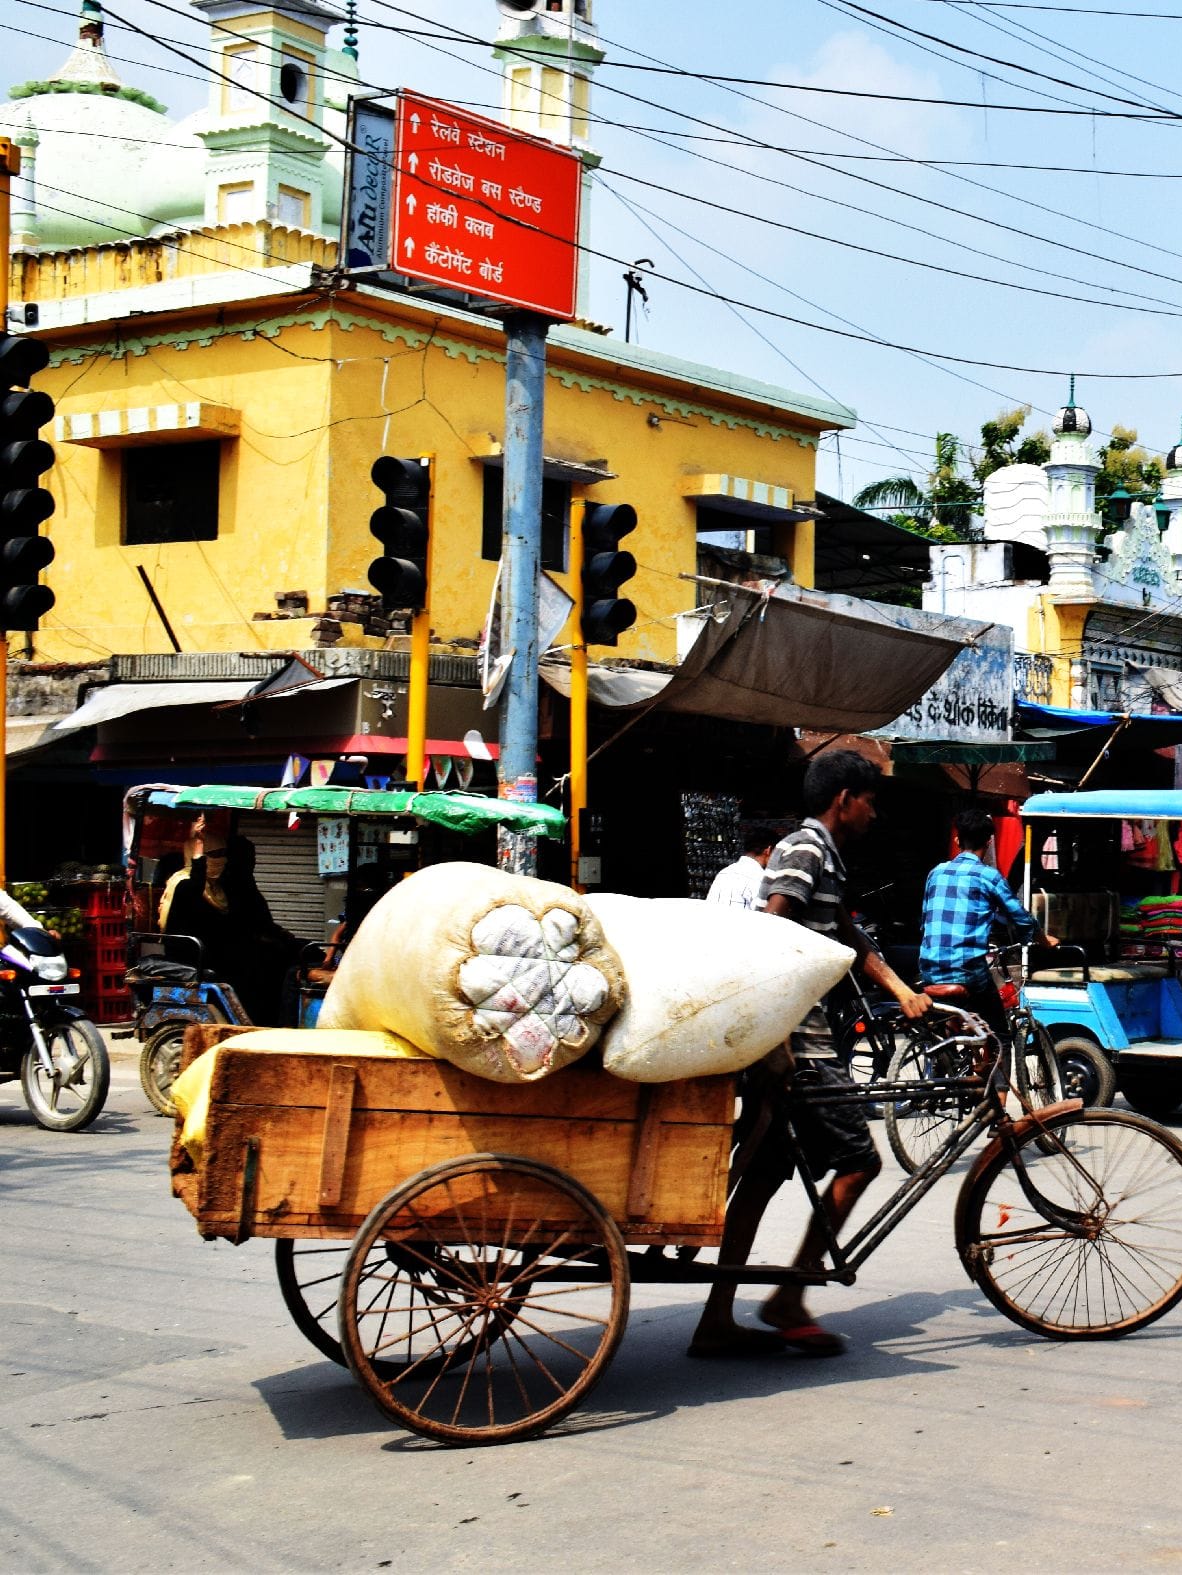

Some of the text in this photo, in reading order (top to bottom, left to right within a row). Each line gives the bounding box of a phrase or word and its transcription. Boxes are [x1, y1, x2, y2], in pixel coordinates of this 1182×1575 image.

[430, 113, 506, 161] रेलवे स्टेशन
[481, 178, 502, 200] बस
[508, 185, 543, 213] स्टैण्ड
[426, 202, 495, 239] हॉकी क्लब
[478, 256, 504, 283] बोर्ड
